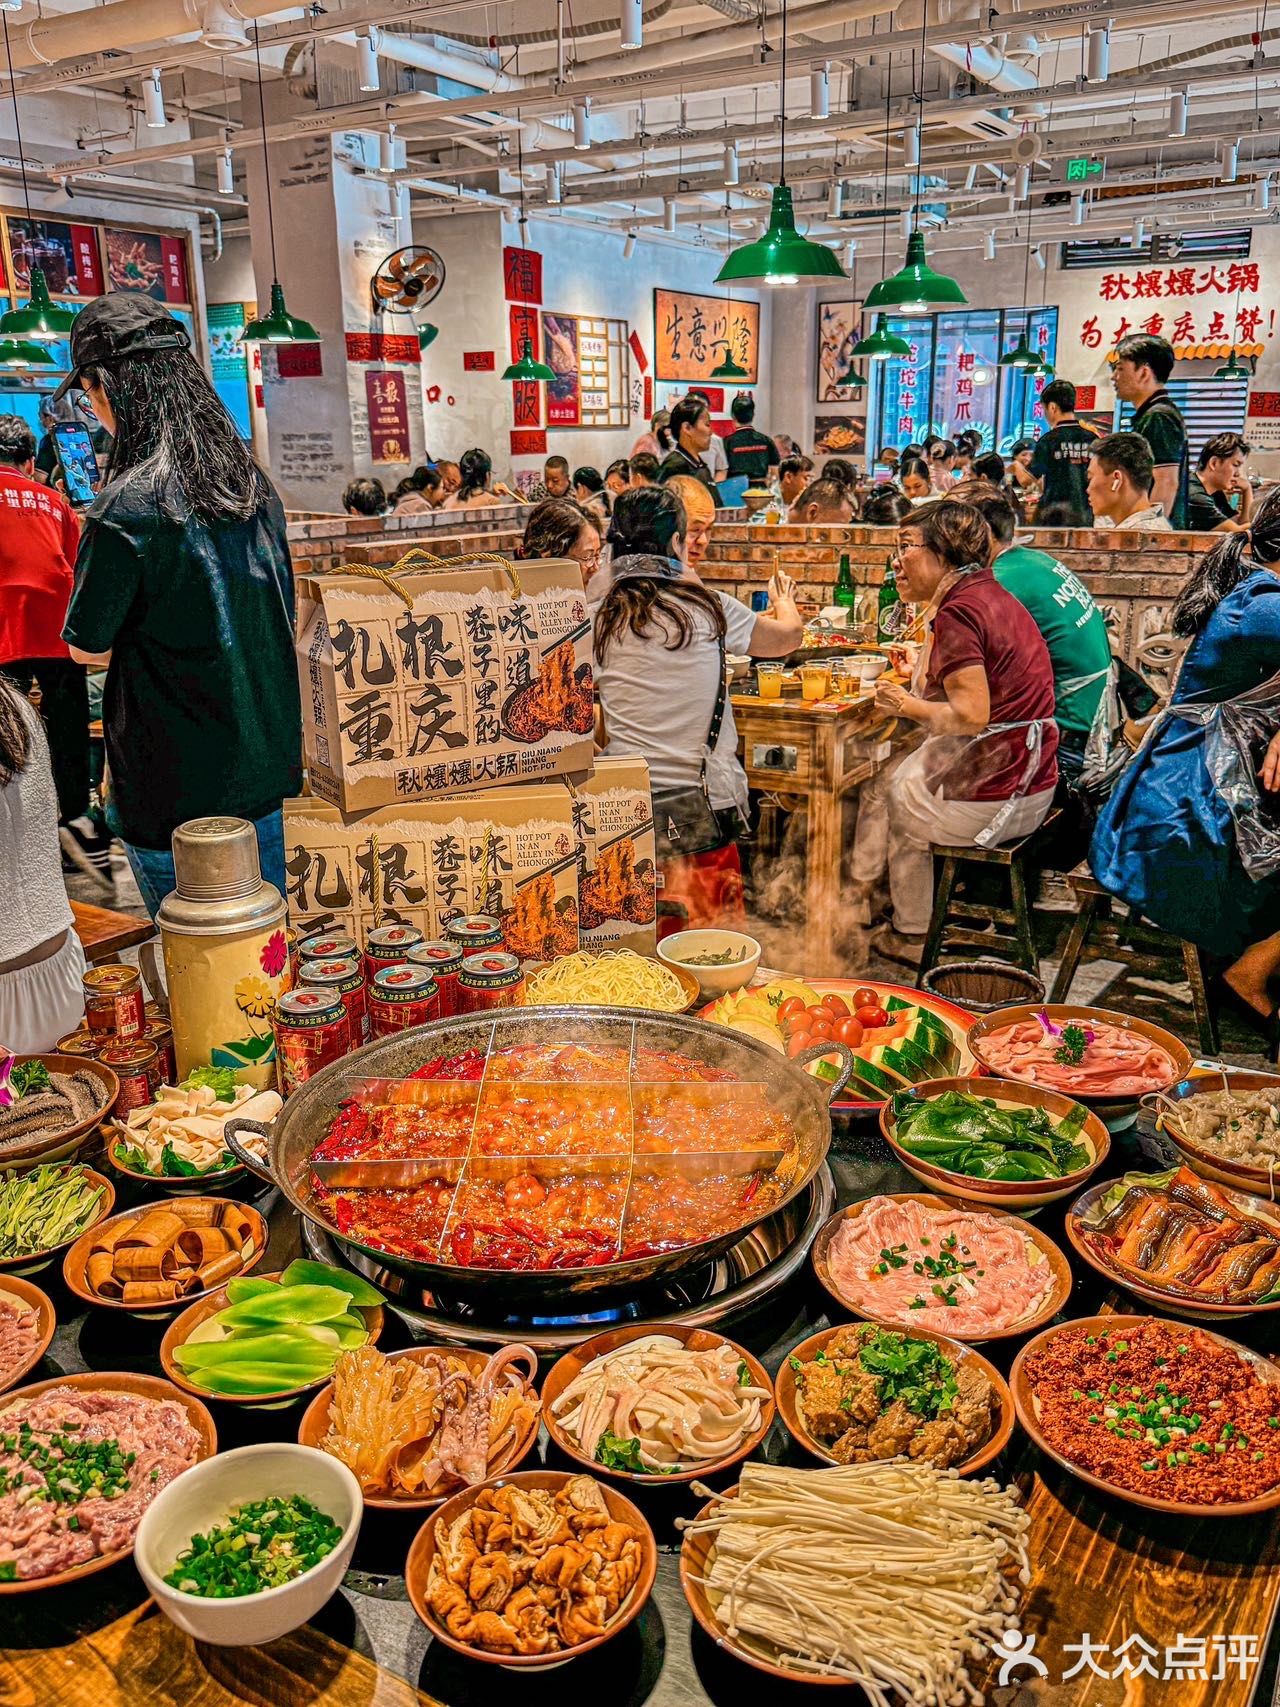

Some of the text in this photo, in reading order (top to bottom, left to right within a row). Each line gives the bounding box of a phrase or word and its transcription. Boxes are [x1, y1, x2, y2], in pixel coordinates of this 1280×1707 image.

[537, 601, 568, 610] HOT POT
[538, 610, 559, 619] IN AN
[540, 618, 563, 627] ALLEY
[340, 683, 469, 766] 重庆
[521, 746, 562, 759] QIU NIANG
[521, 756, 547, 766] NIANG
[521, 762, 556, 774] HOT POT
[598, 800, 632, 809] HOT POT
[599, 809, 608, 817] IN
[600, 815, 634, 824] ALLEY IN
[516, 834, 533, 842] HOT
[516, 842, 540, 851] IN AN
[517, 849, 554, 859] ALLEY IN
[593, 933, 620, 941] NIANG
